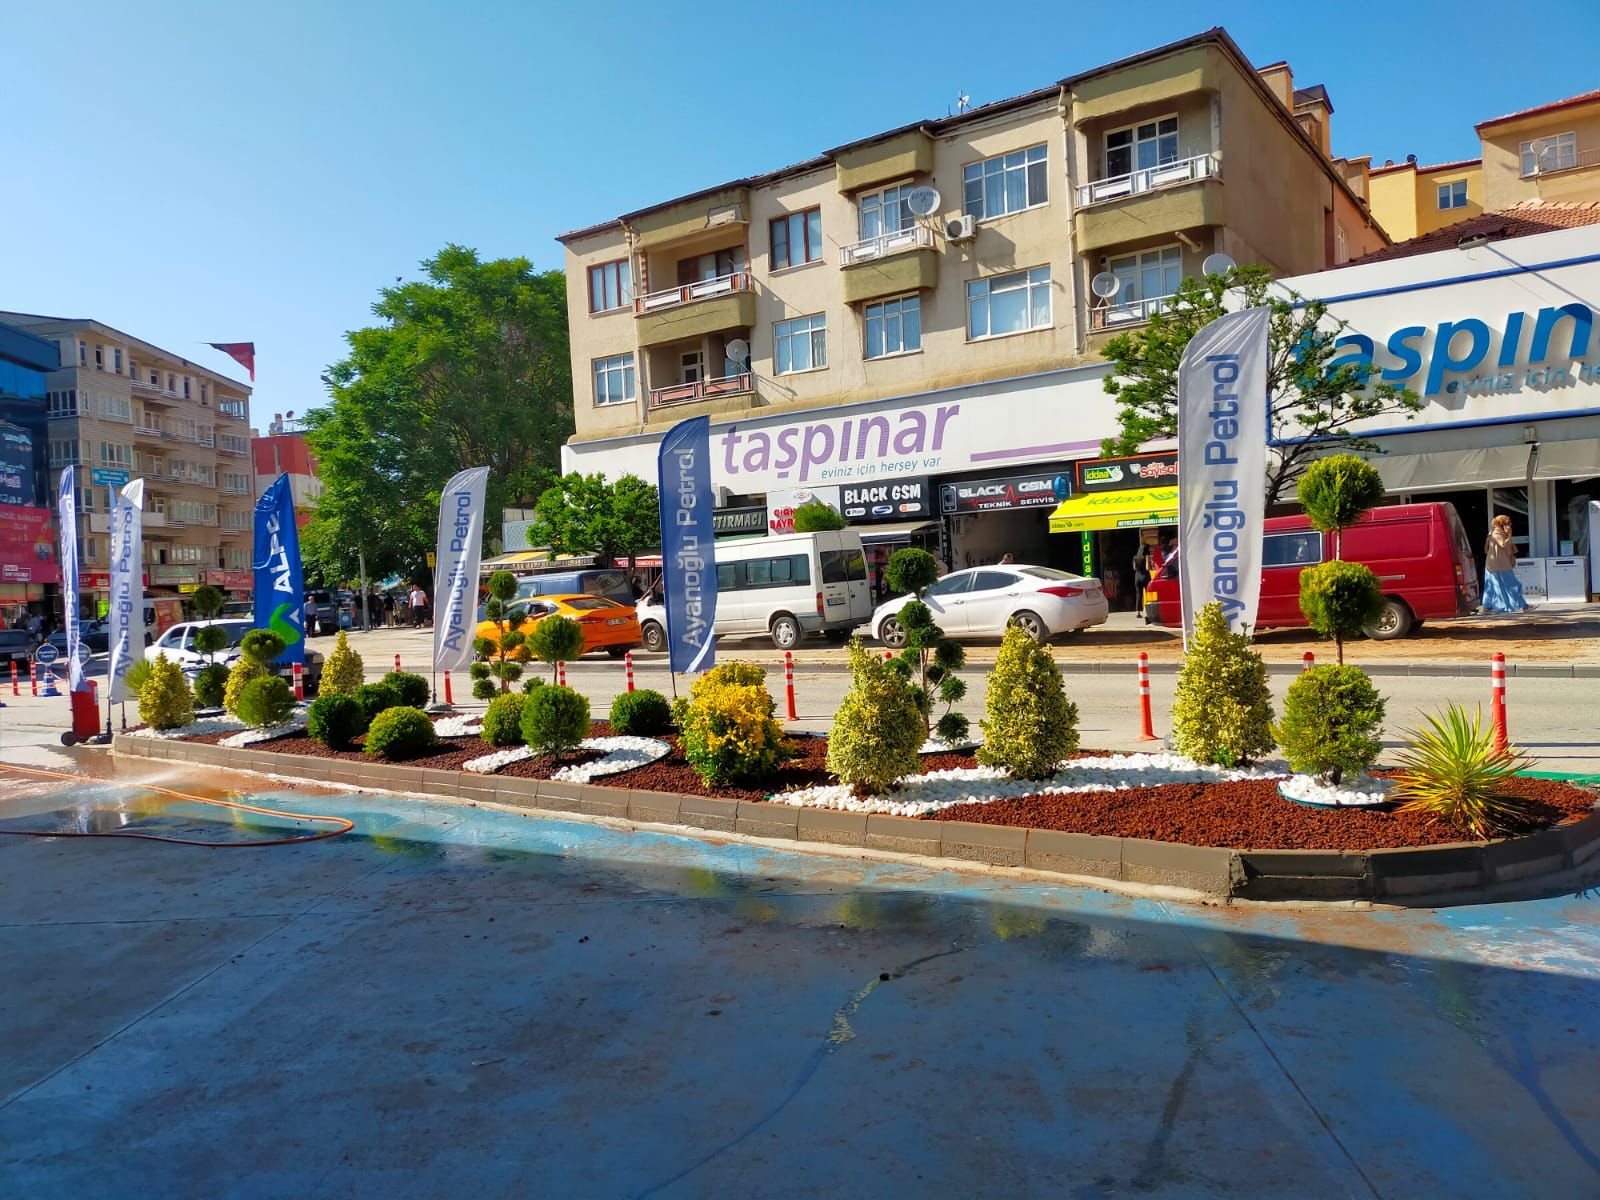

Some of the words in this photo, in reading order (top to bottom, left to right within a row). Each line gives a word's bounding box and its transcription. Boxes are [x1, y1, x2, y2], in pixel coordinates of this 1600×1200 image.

[1290, 303, 1600, 396] taşpın
[721, 405, 960, 482] taşpınar
[1205, 354, 1239, 465] Petrol
[673, 448, 698, 526] Petrol
[821, 467, 853, 479] eviniz
[857, 464, 876, 475] için
[880, 460, 918, 472] herşey
[923, 457, 941, 467] var
[844, 486, 888, 504] BLACK
[891, 483, 921, 500] GSM
[959, 484, 1007, 498] BLACK
[1018, 479, 1053, 492] GSM
[979, 500, 1012, 509] TEKNİK
[1020, 496, 1055, 505] SERVİS
[119, 506, 133, 573] Petrol
[266, 510, 294, 595] ALPE
[450, 492, 472, 552] Petrol
[713, 512, 763, 529] STIRMACI
[444, 560, 469, 651] Ayanoğlu
[677, 535, 707, 648] Ayanoğlu
